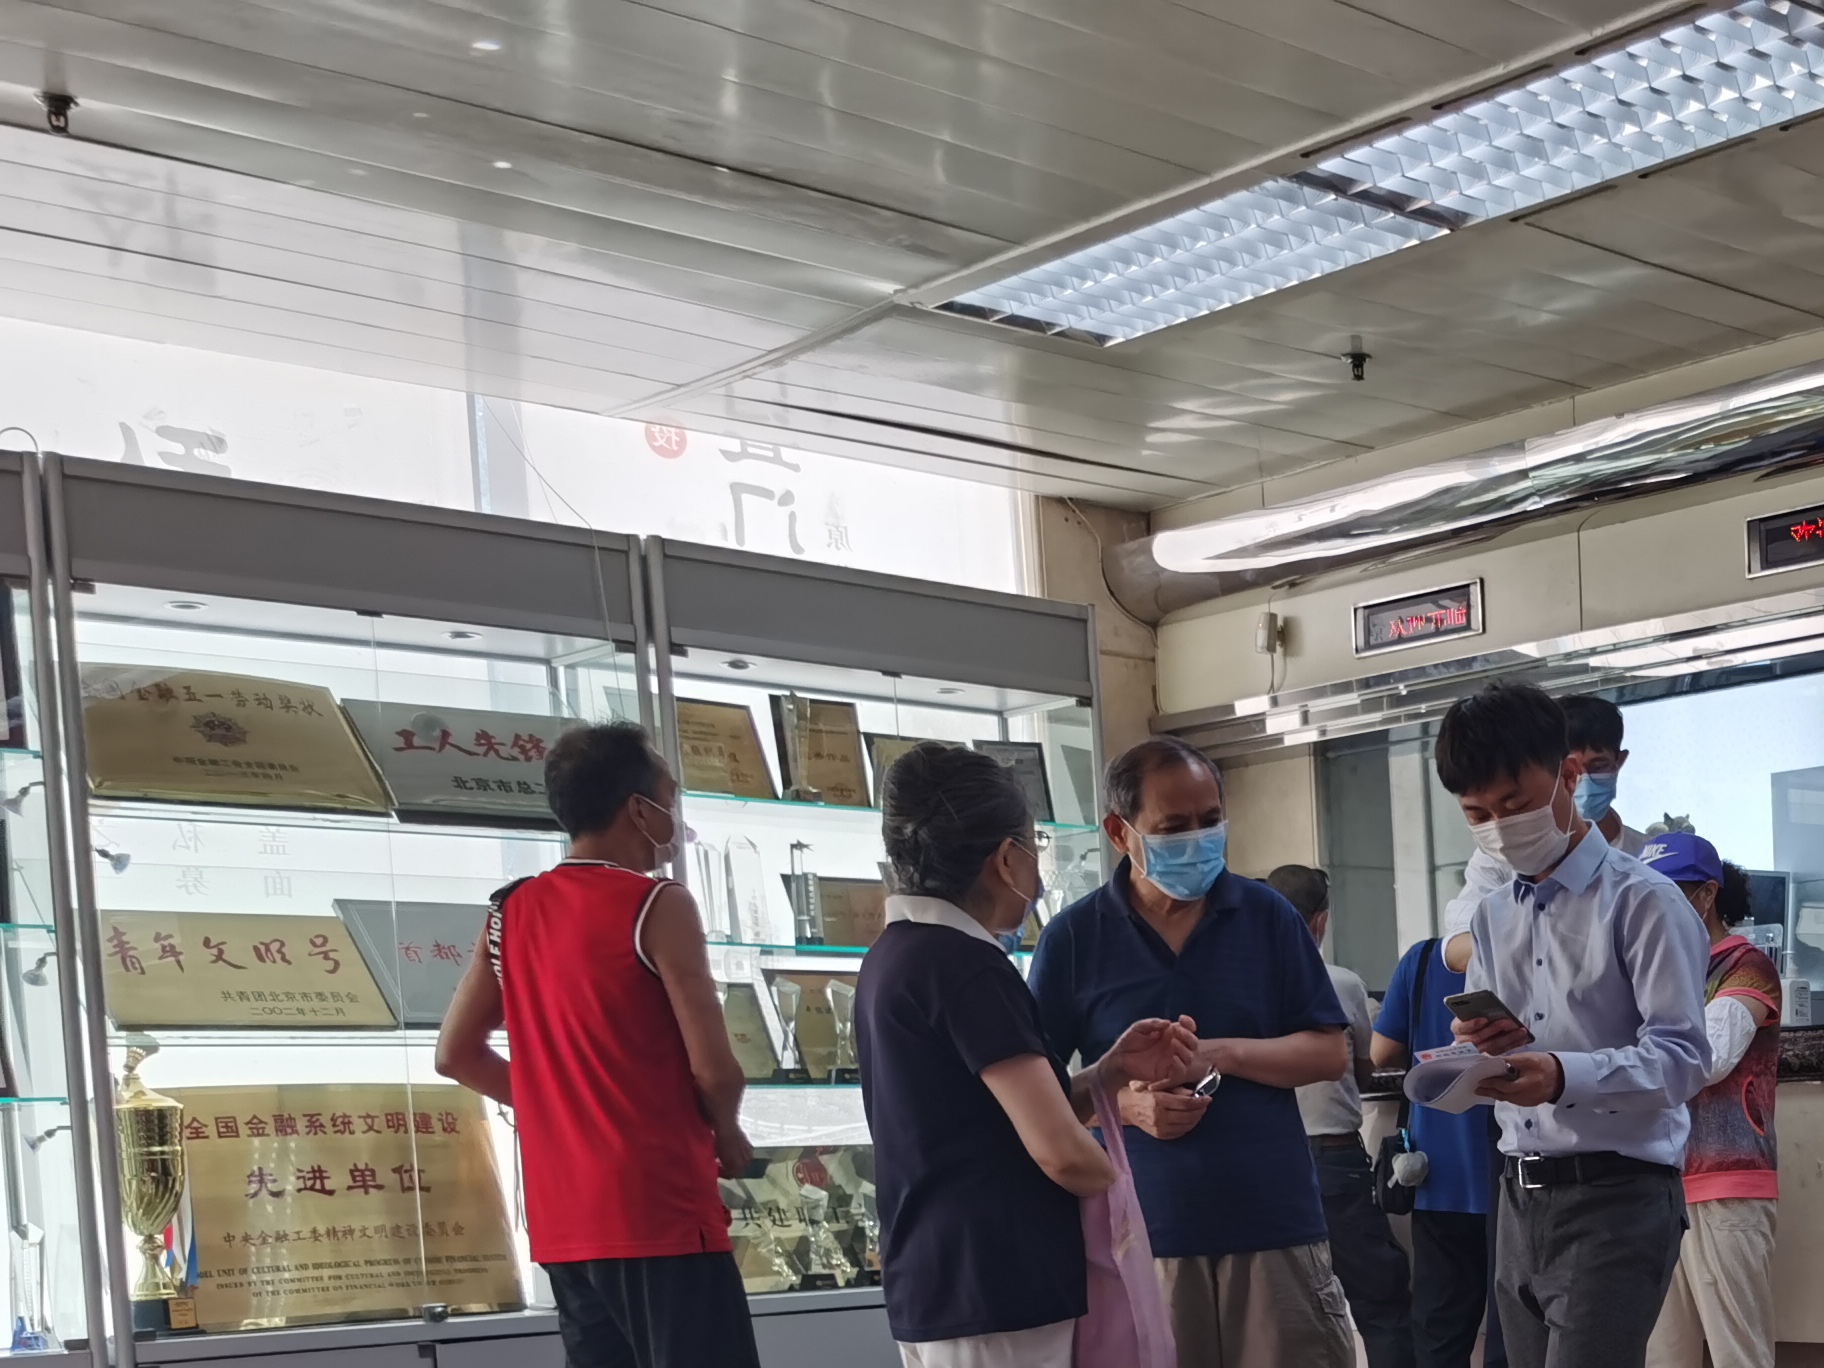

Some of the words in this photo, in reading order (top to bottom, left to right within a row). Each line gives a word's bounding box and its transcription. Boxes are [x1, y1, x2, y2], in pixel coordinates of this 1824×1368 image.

[1639, 843, 1668, 860] NIKE
[106, 925, 341, 975] 青年文明号
[398, 939, 476, 967] 首都
[184, 1111, 461, 1141] 全国金融系统文明建设
[245, 1162, 431, 1199] 先进单位
